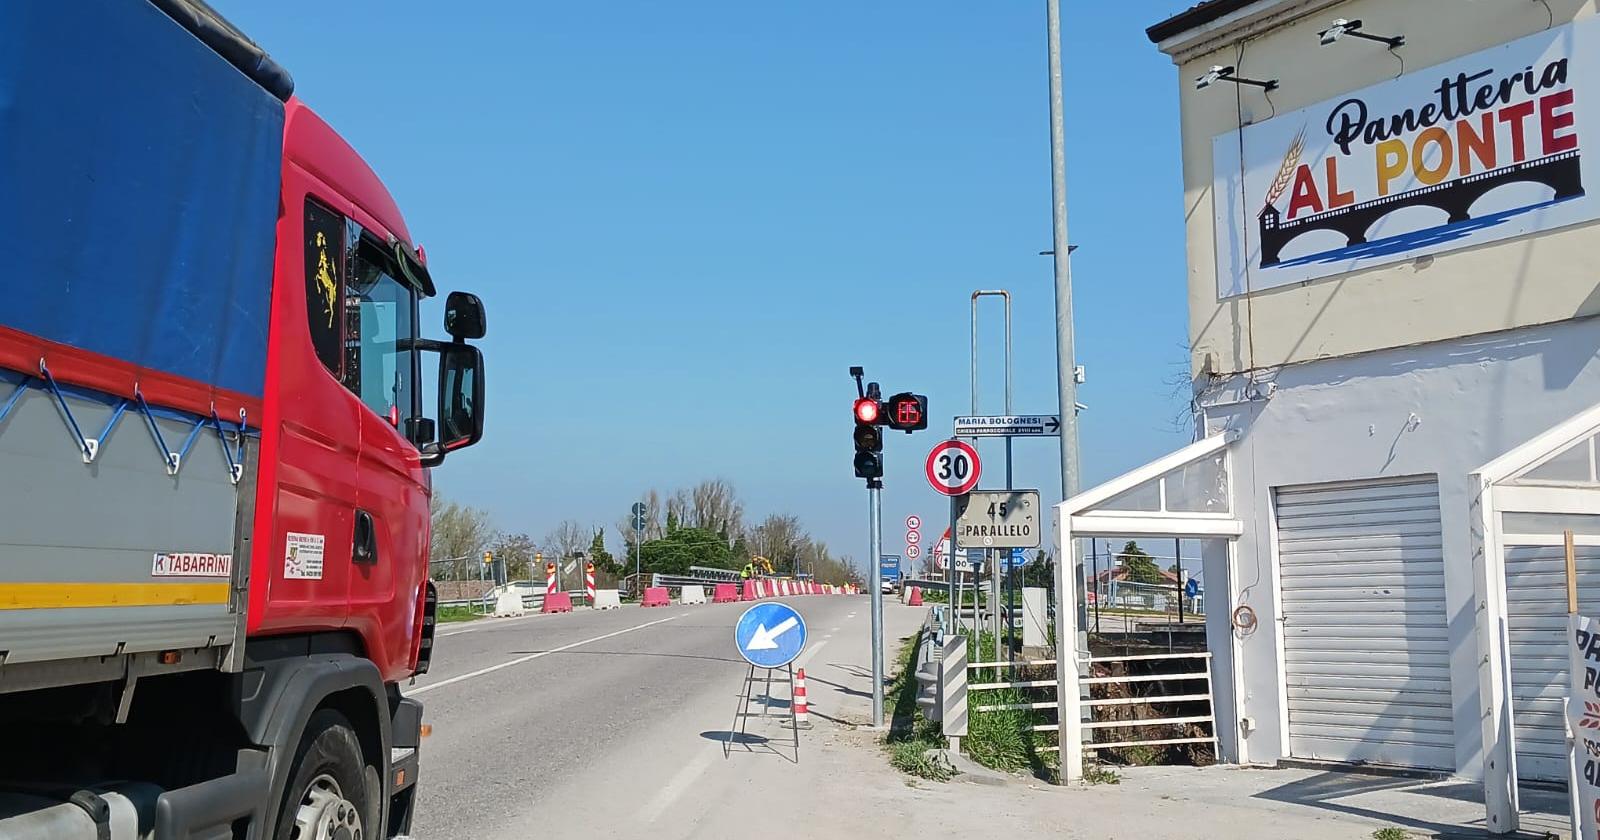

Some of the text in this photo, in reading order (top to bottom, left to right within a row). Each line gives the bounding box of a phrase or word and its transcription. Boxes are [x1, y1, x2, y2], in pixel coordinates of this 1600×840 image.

[1326, 57, 1568, 156] Panetteria
[1287, 88, 1578, 219] AL PONTE
[959, 417, 1041, 425] MARIA BOLOGNESI
[938, 454, 969, 480] 30
[987, 502, 1007, 517] 45
[965, 525, 1031, 537] PARALLELO
[168, 555, 229, 572] TABARRINI
